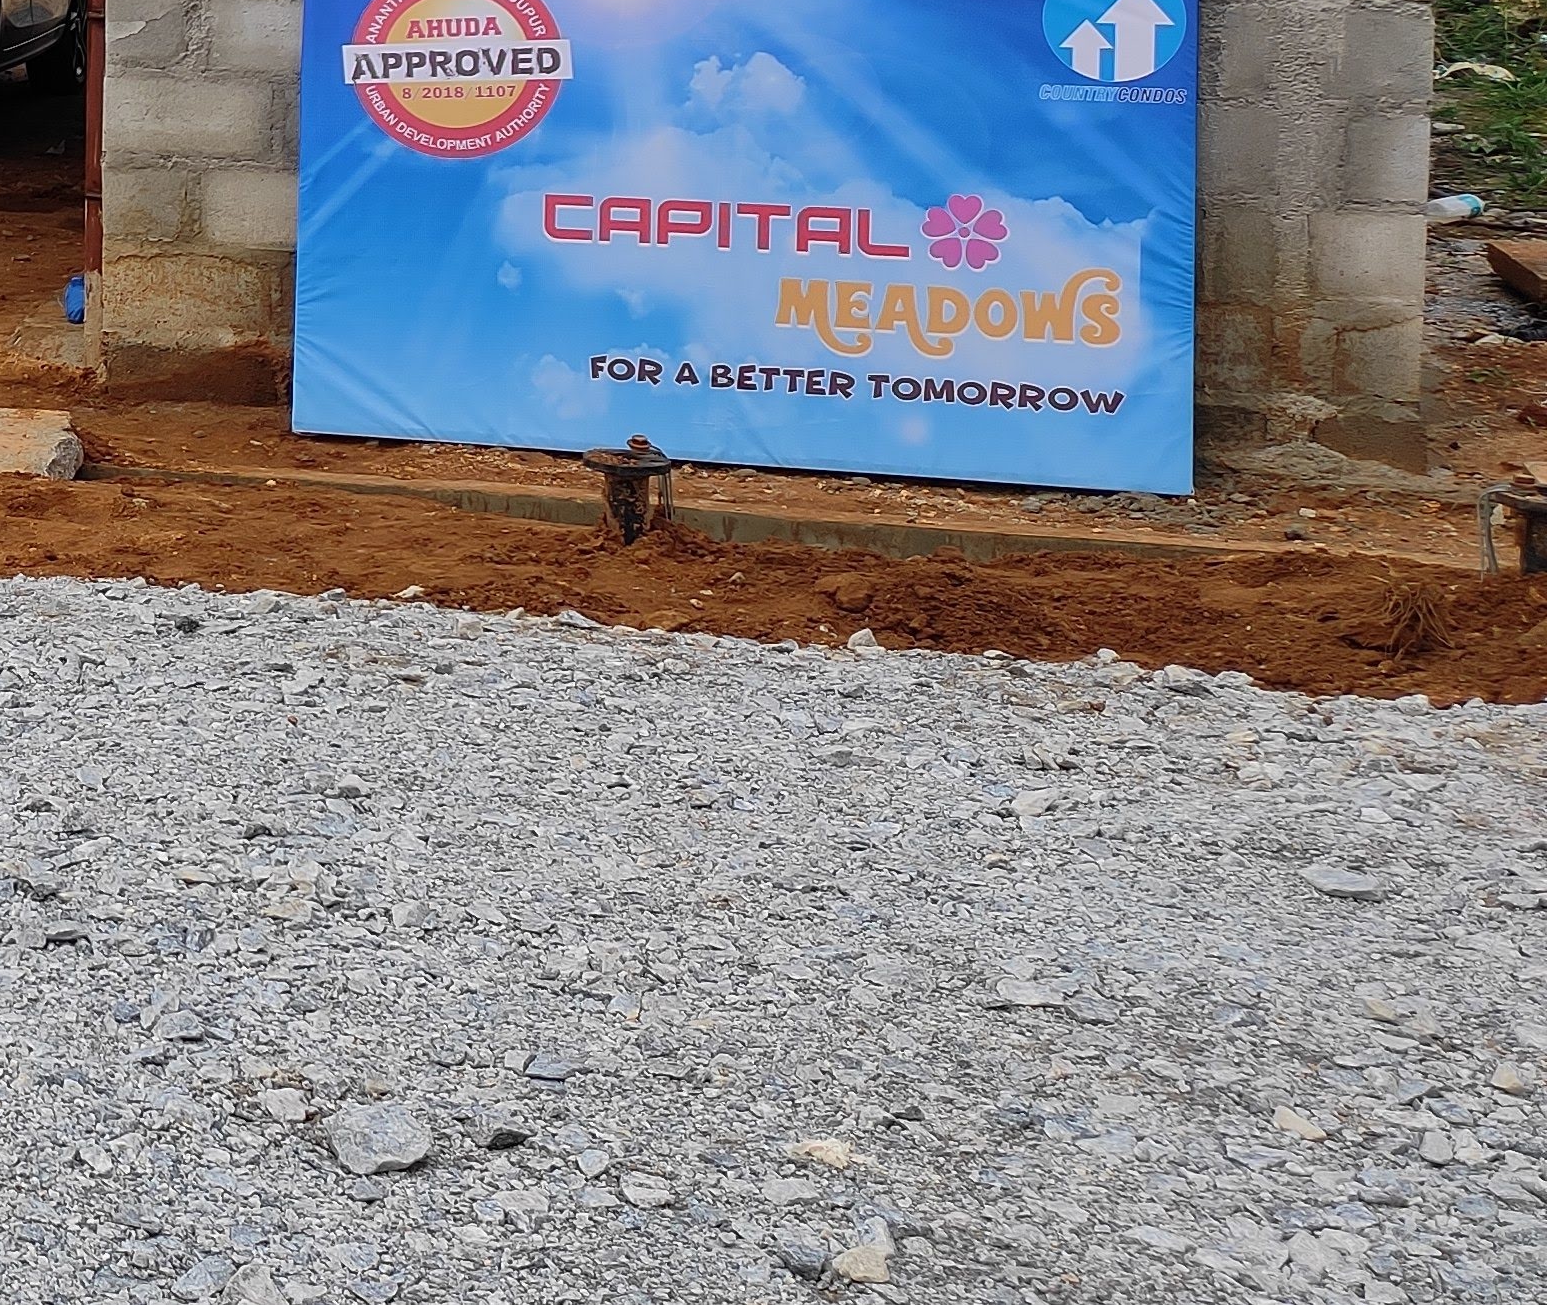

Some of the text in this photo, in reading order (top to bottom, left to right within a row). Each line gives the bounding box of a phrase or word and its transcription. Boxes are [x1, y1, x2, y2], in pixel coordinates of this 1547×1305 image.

[406, 16, 502, 39] AHUDA
[351, 46, 562, 81] APPROVED
[402, 85, 517, 100] 8/2018/1107
[365, 83, 551, 150] URBAN DEVELOPMENT AUTHORITY
[543, 193, 911, 259] CAPITAL
[774, 267, 1123, 358] MEADOWS
[589, 353, 1126, 416] FOR A BETTER TOMORROW
